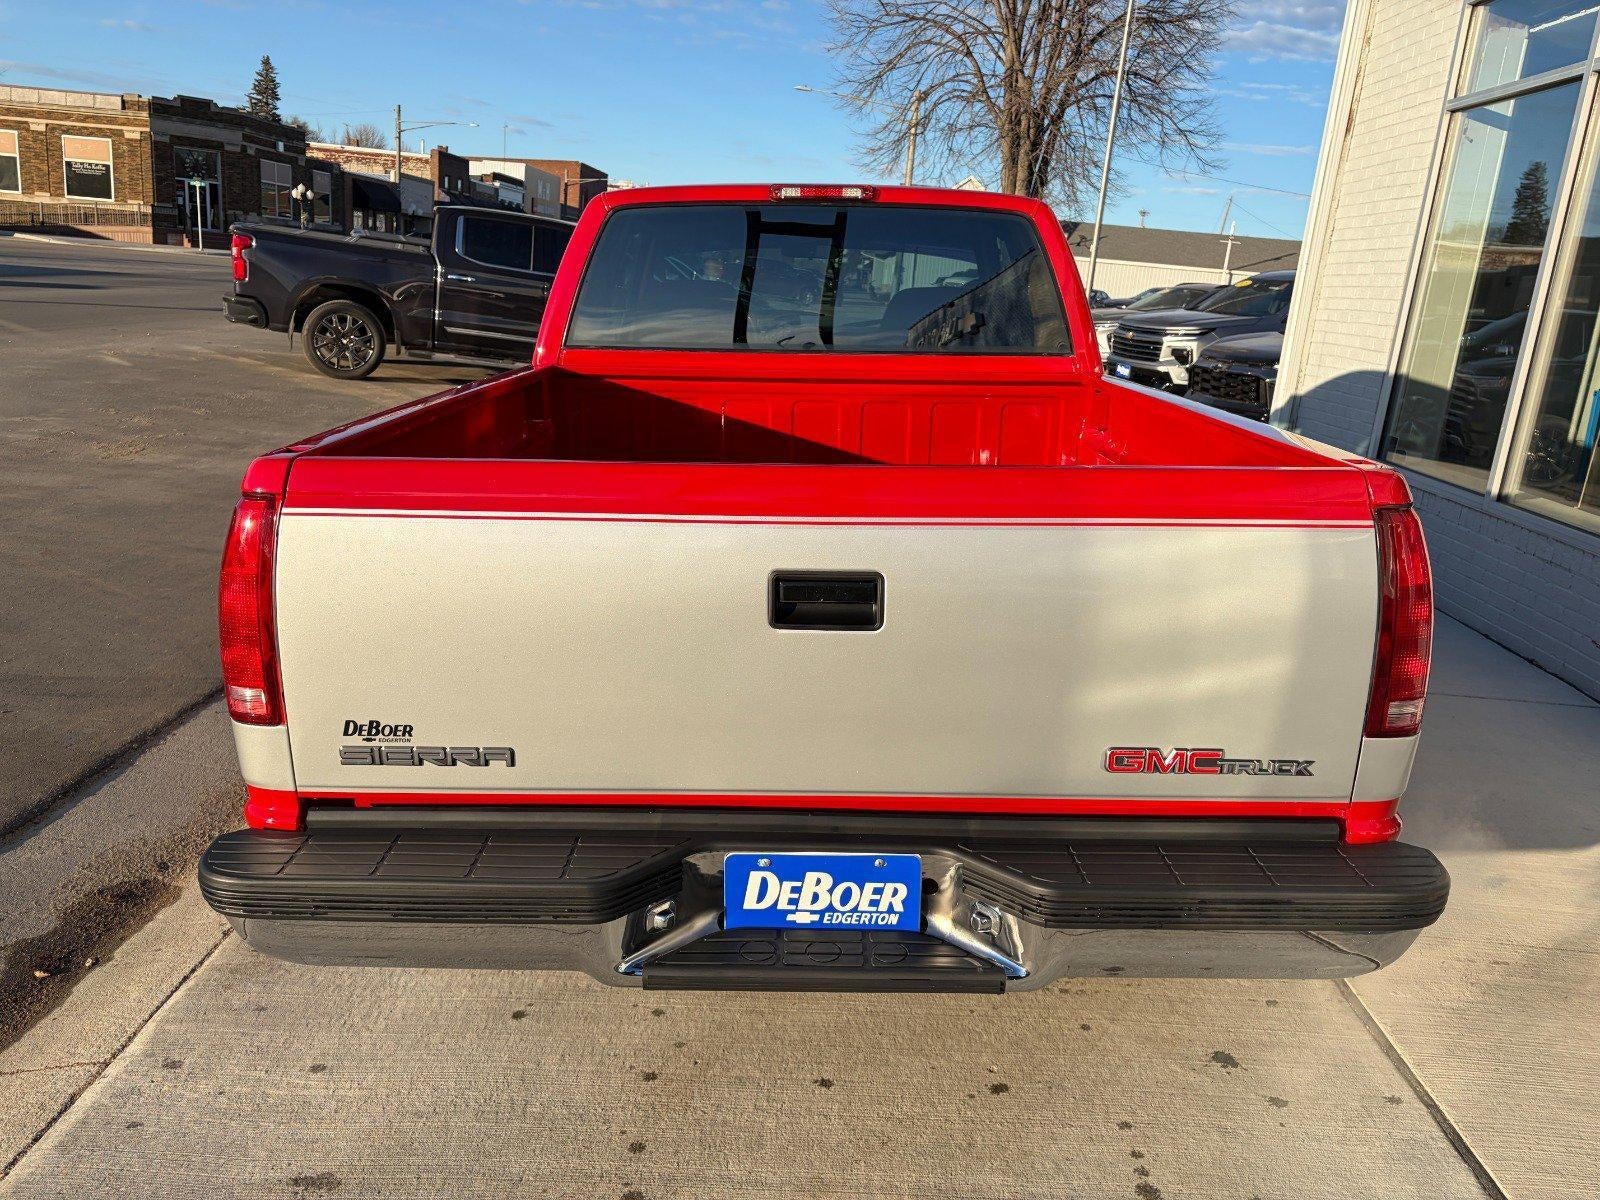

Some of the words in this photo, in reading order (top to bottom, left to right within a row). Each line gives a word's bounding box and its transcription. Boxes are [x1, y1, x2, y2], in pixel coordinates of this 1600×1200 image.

[339, 745, 516, 767] SIERRA
[1105, 746, 1225, 775] GMC
[1217, 758, 1316, 776] TRUCK
[823, 912, 900, 925] EDGERTON
